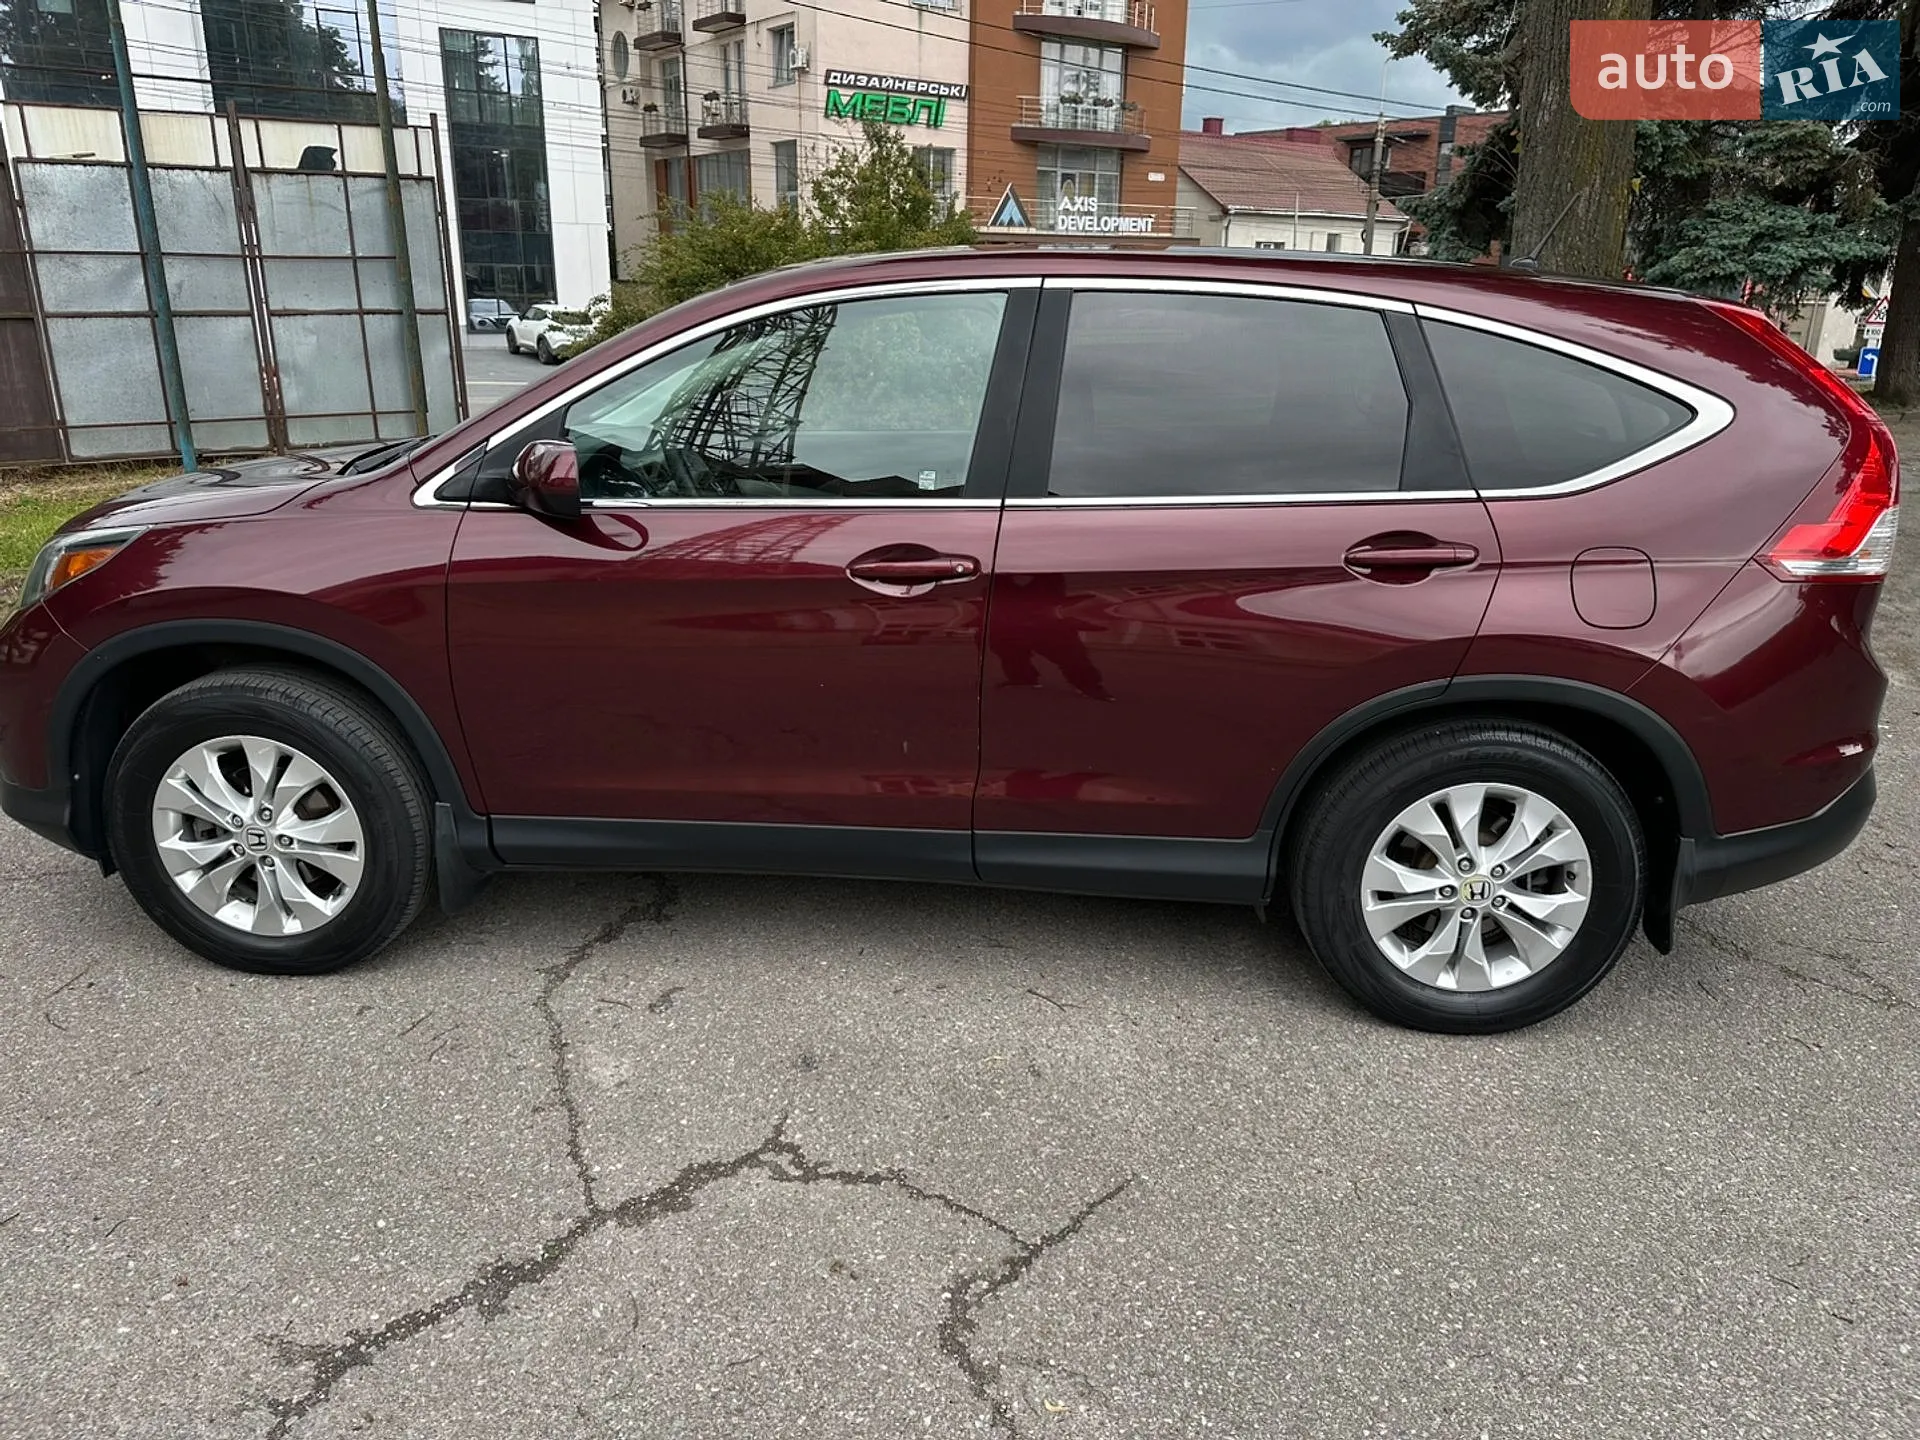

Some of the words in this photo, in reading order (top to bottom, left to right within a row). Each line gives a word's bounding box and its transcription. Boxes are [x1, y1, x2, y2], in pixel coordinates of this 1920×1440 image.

[828, 71, 966, 98] ДИЗАЙНЕРСЬКІ
[825, 88, 946, 128] МЕБЛІ
[1058, 196, 1098, 212] AXIS
[1058, 215, 1154, 232] DEVELOPMENT
